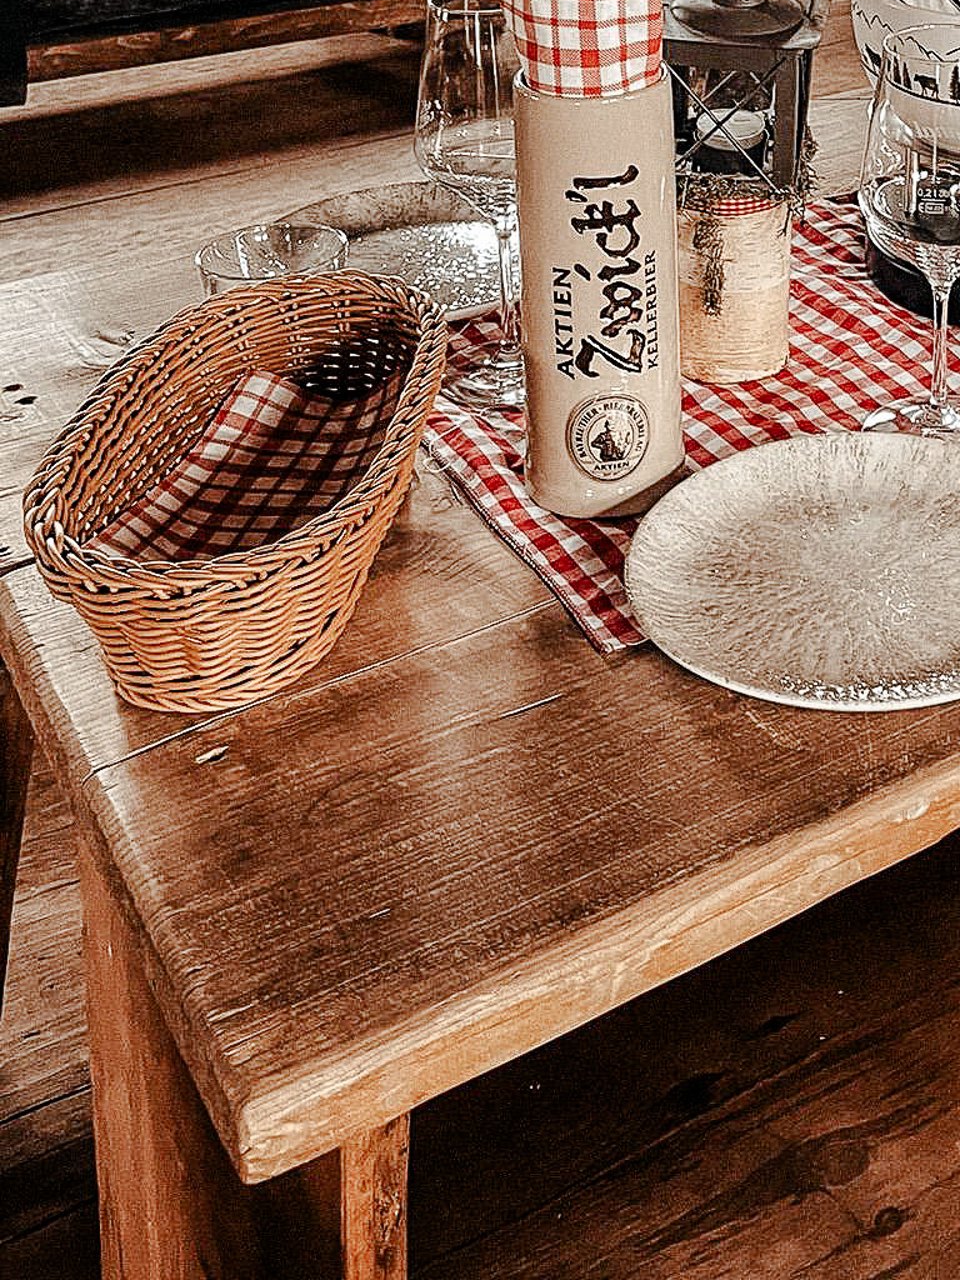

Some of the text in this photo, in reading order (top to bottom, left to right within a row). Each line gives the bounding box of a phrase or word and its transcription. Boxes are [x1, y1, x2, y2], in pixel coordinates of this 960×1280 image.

[552, 267, 576, 380] AKTIEN
[644, 249, 659, 370] KELLERBIER
[593, 459, 631, 471] AKTIEN
